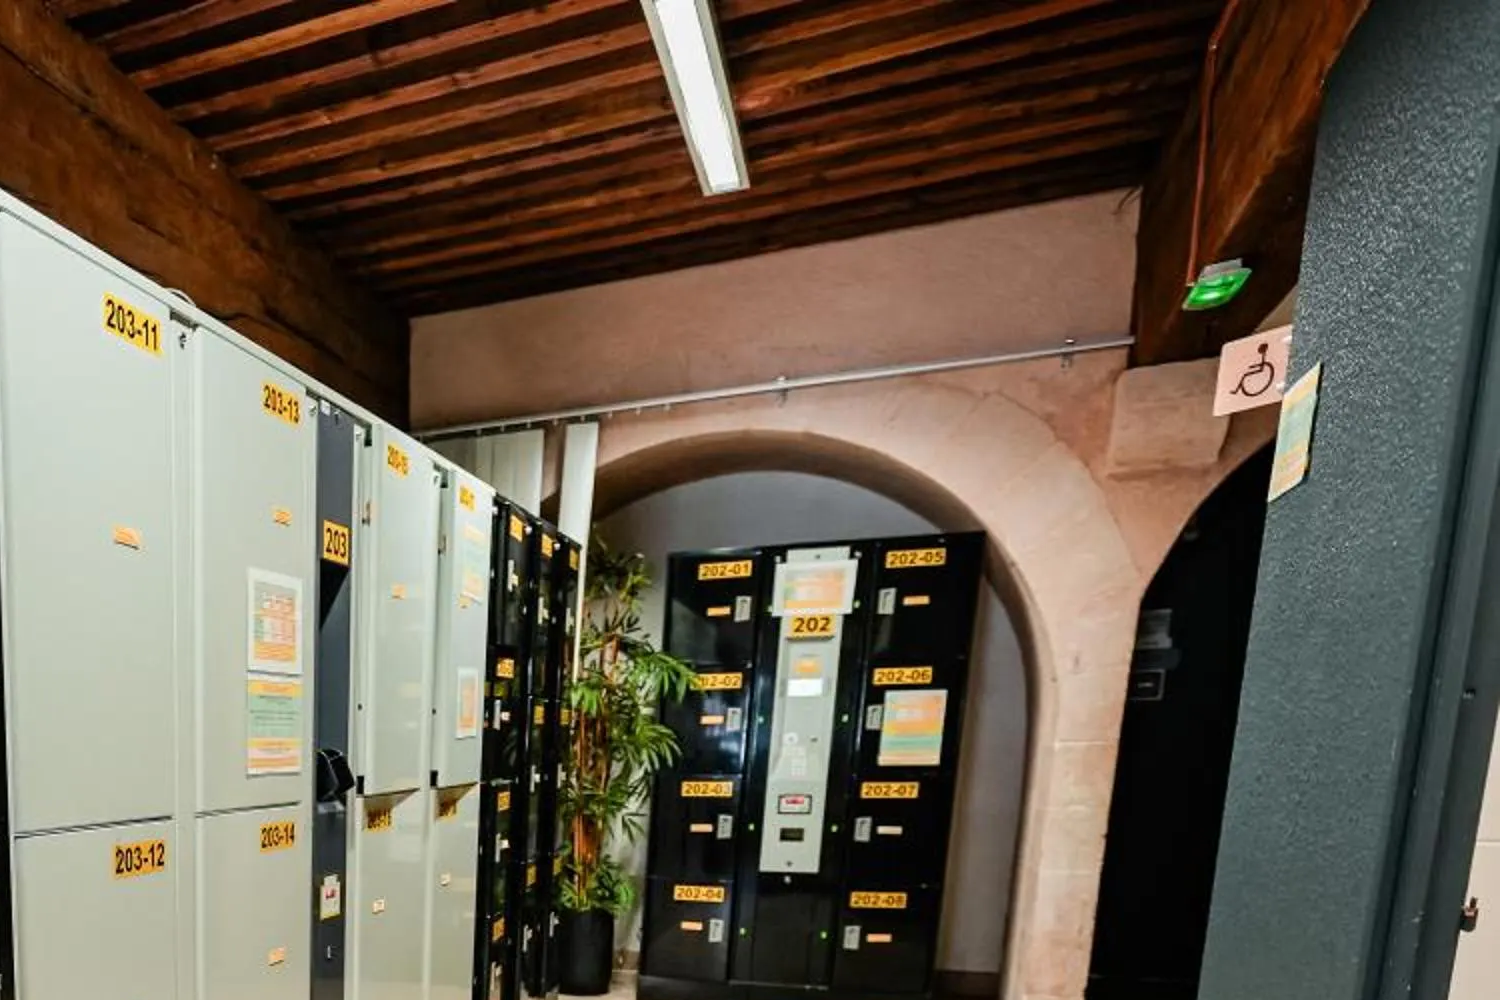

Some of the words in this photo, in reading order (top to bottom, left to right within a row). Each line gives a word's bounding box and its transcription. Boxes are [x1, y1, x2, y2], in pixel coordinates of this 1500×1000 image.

[105, 299, 158, 350] 203-11
[263, 384, 299, 424] 203-13
[326, 527, 346, 558] 203
[889, 550, 944, 566] 202-05
[701, 562, 750, 578] 202-01
[793, 617, 831, 633] 202
[692, 674, 740, 687] 02-02
[876, 669, 931, 683] 202-06
[864, 783, 916, 797] 202-07
[261, 823, 295, 849] 203-14
[115, 842, 164, 875] 203-12
[676, 887, 722, 900] 202-04
